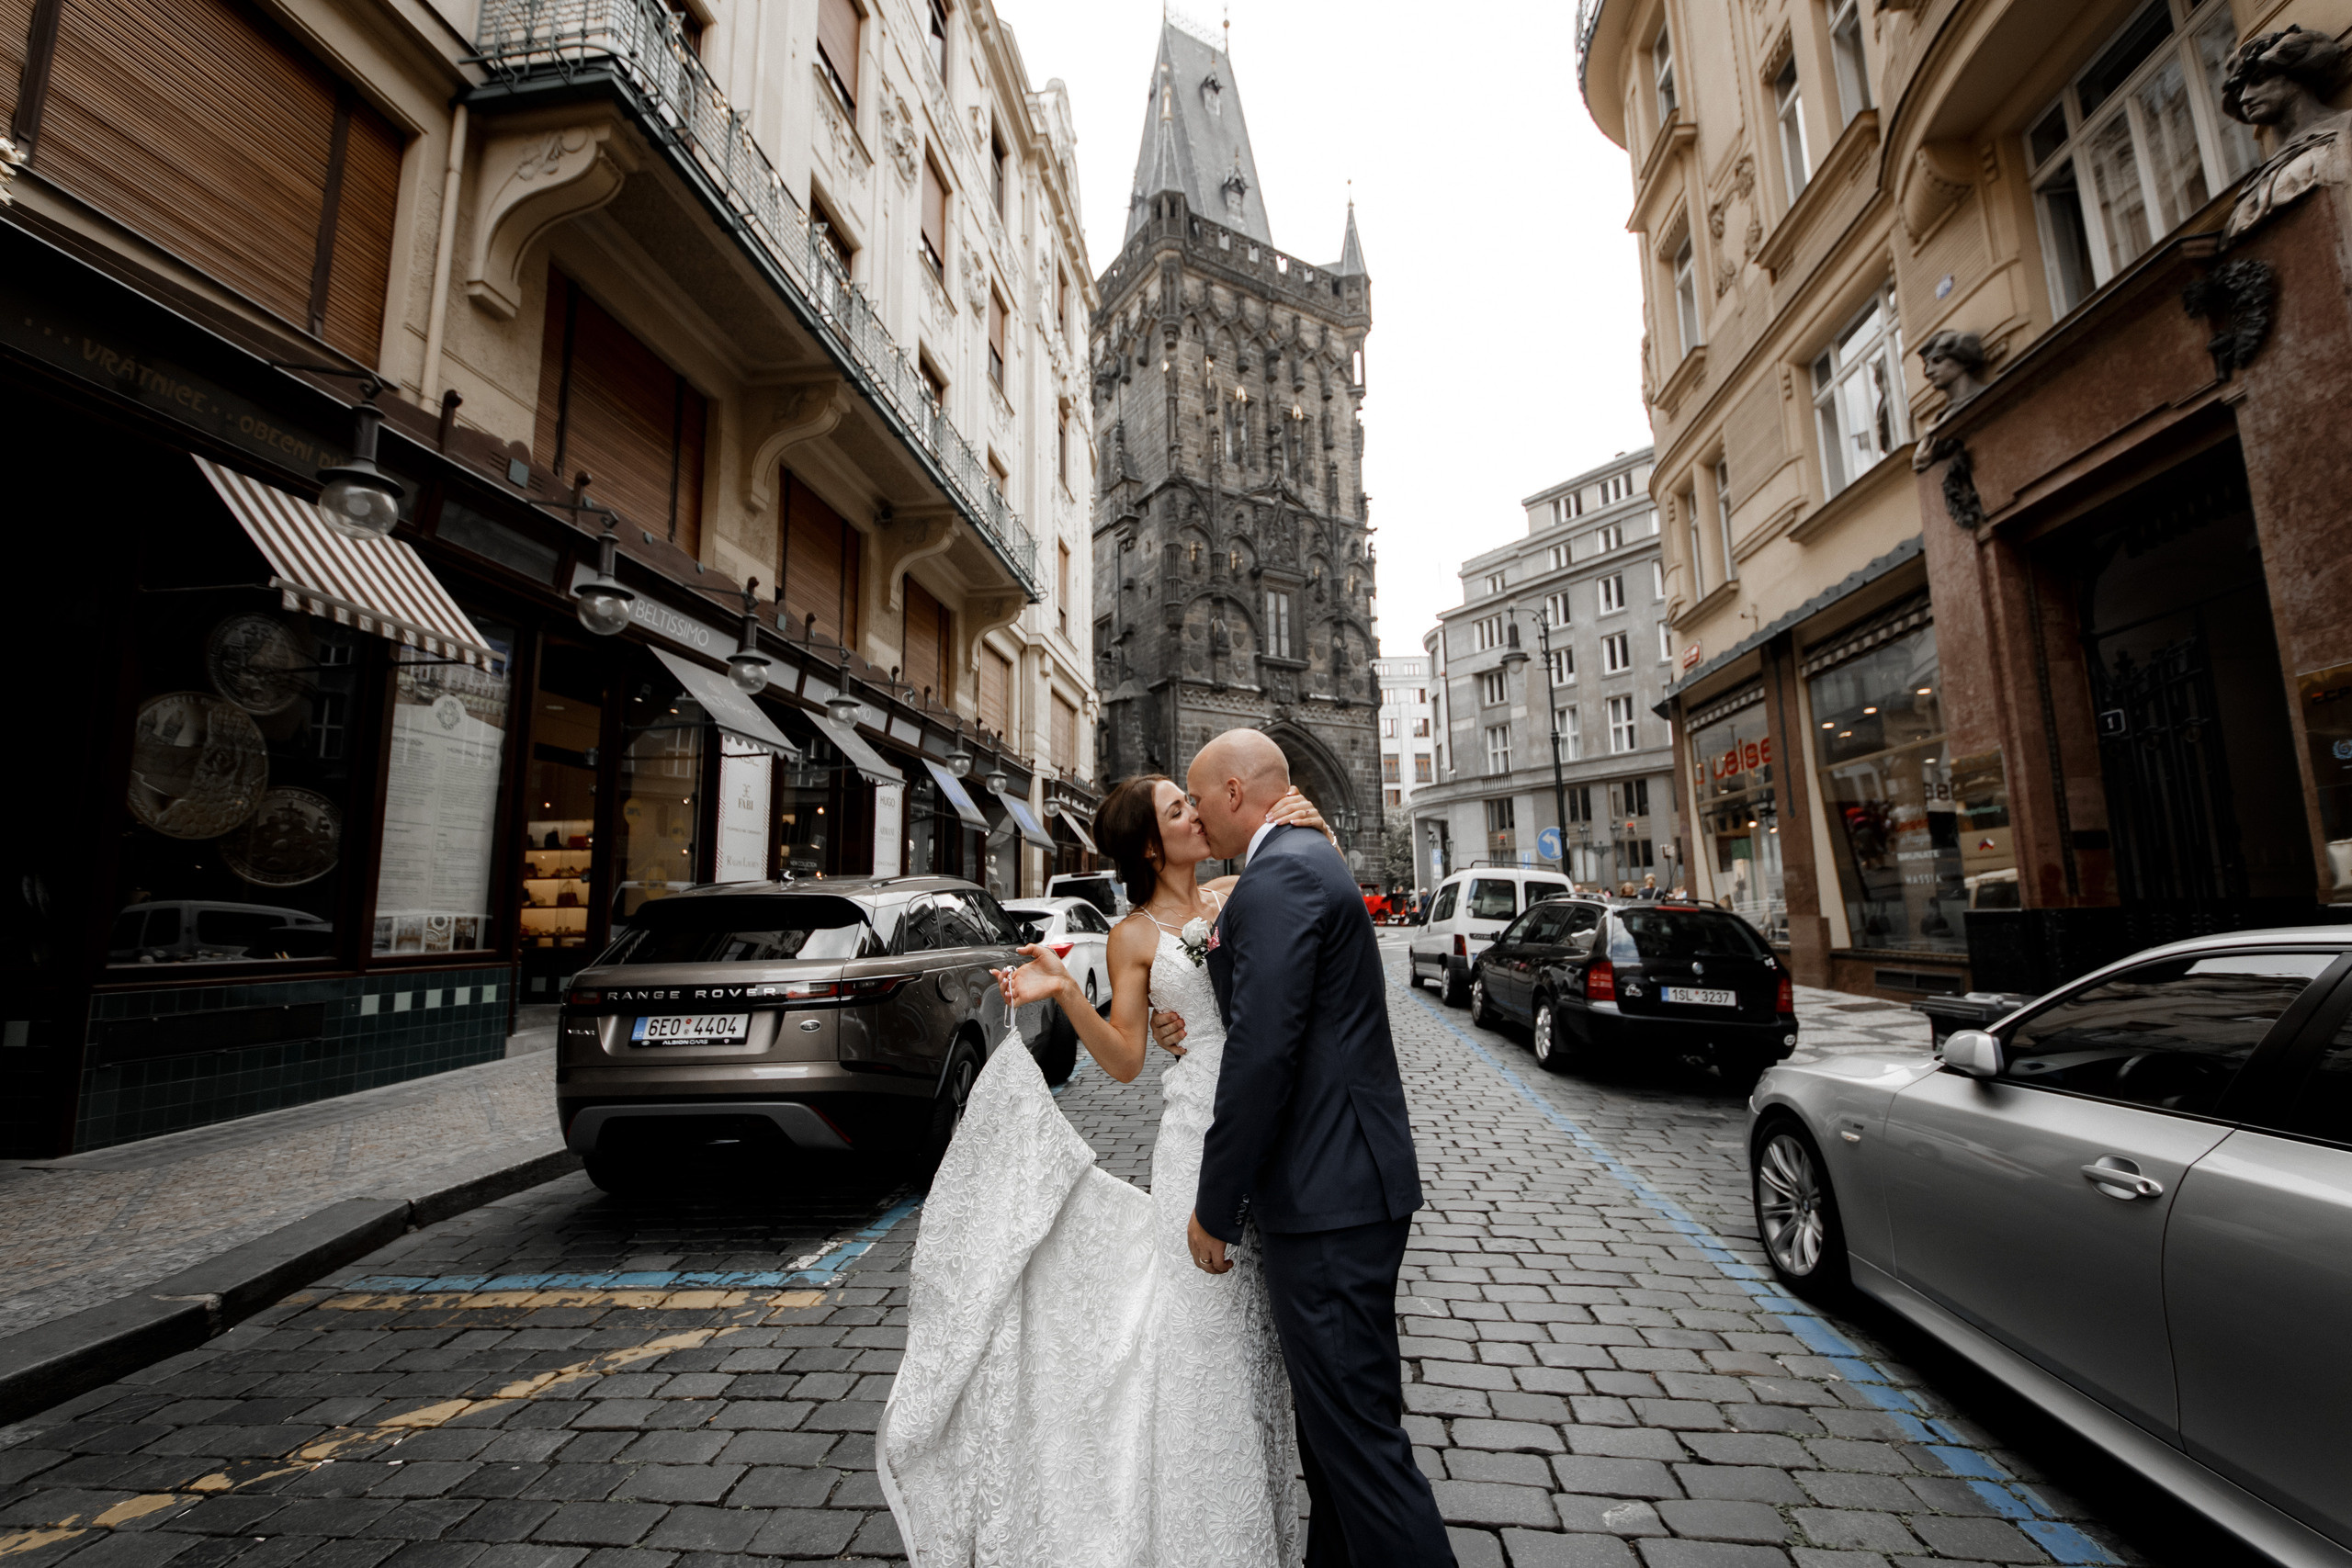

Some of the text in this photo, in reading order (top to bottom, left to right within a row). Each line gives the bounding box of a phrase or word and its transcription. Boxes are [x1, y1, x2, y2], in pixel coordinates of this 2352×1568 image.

[83, 336, 209, 413] VRÁTNICE
[635, 598, 709, 647] BELTISSIMO
[606, 987, 777, 1000] RANGE ROVER
[1702, 991, 1730, 1004] 3237
[694, 1017, 738, 1035] 4404
